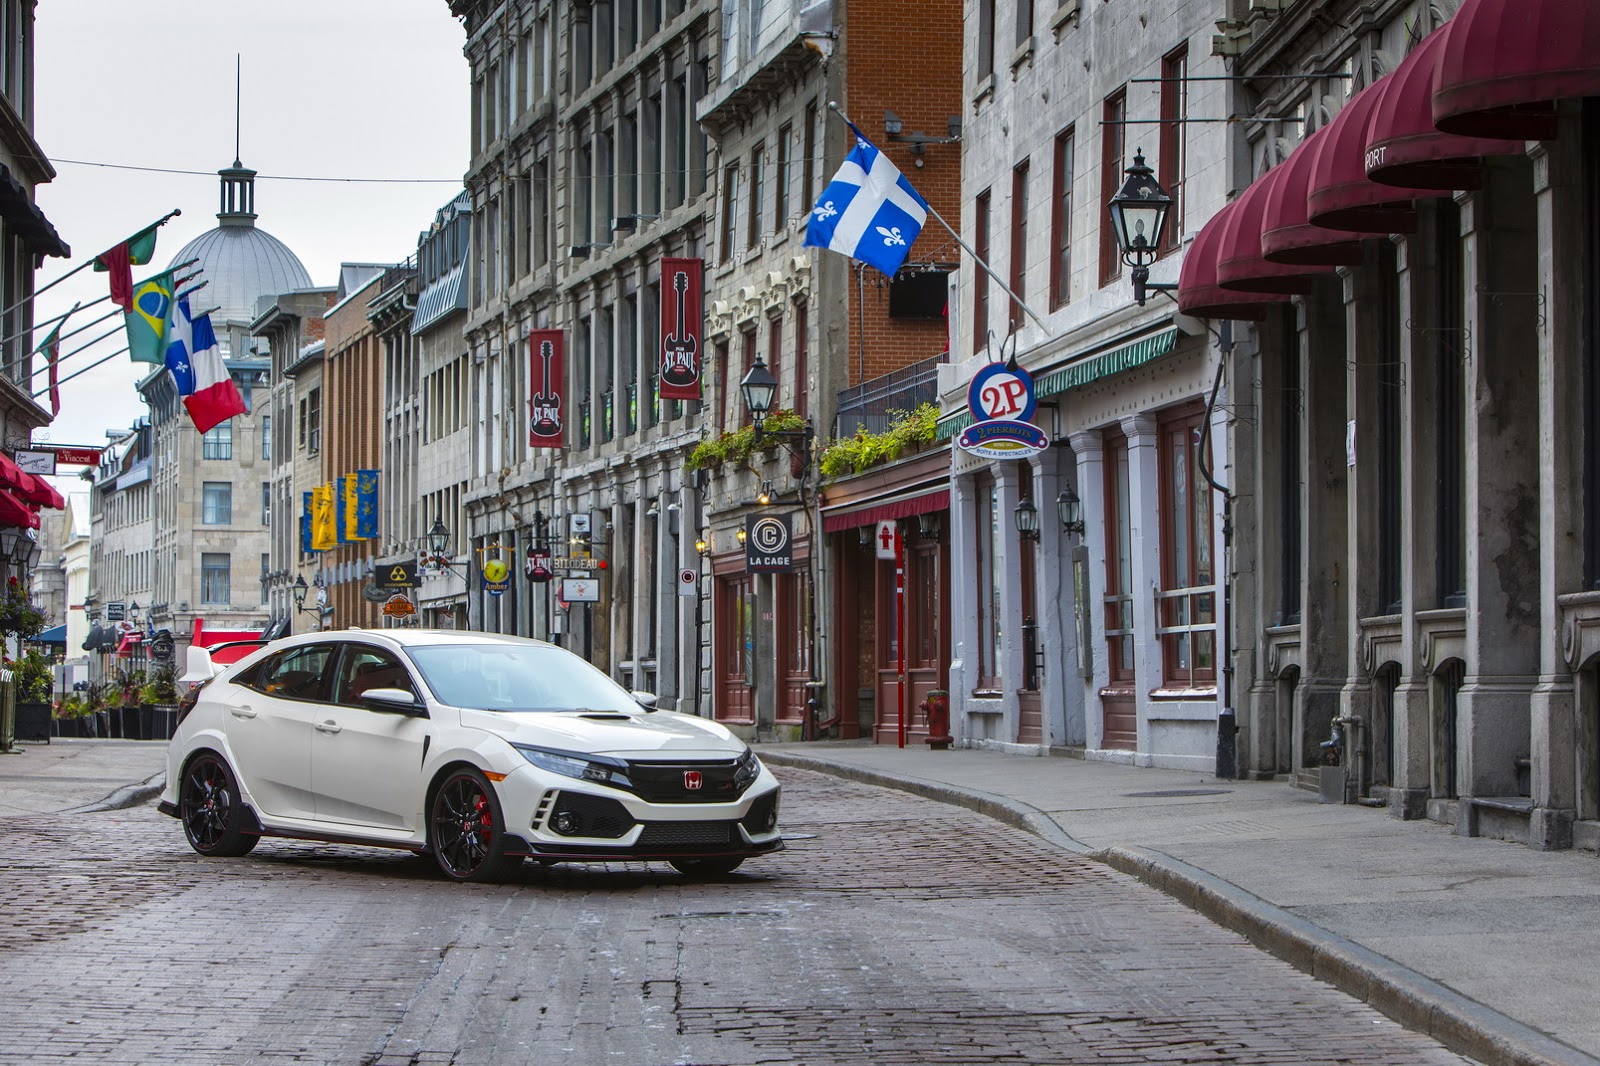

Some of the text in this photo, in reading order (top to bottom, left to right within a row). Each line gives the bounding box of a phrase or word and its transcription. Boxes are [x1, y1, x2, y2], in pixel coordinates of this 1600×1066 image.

[676, 350, 696, 376] PAUL
[981, 378, 1027, 419] 2P
[543, 407, 560, 428] PAUL
[977, 426, 1032, 439] 2 PIERROTS
[57, 453, 91, 463] t-Vincent
[998, 448, 1032, 457] SPECTACLES
[537, 557, 553, 575] PAUL
[553, 558, 598, 569] BILODEAU
[750, 556, 790, 566] LA CAGE
[485, 582, 508, 590] Amber
